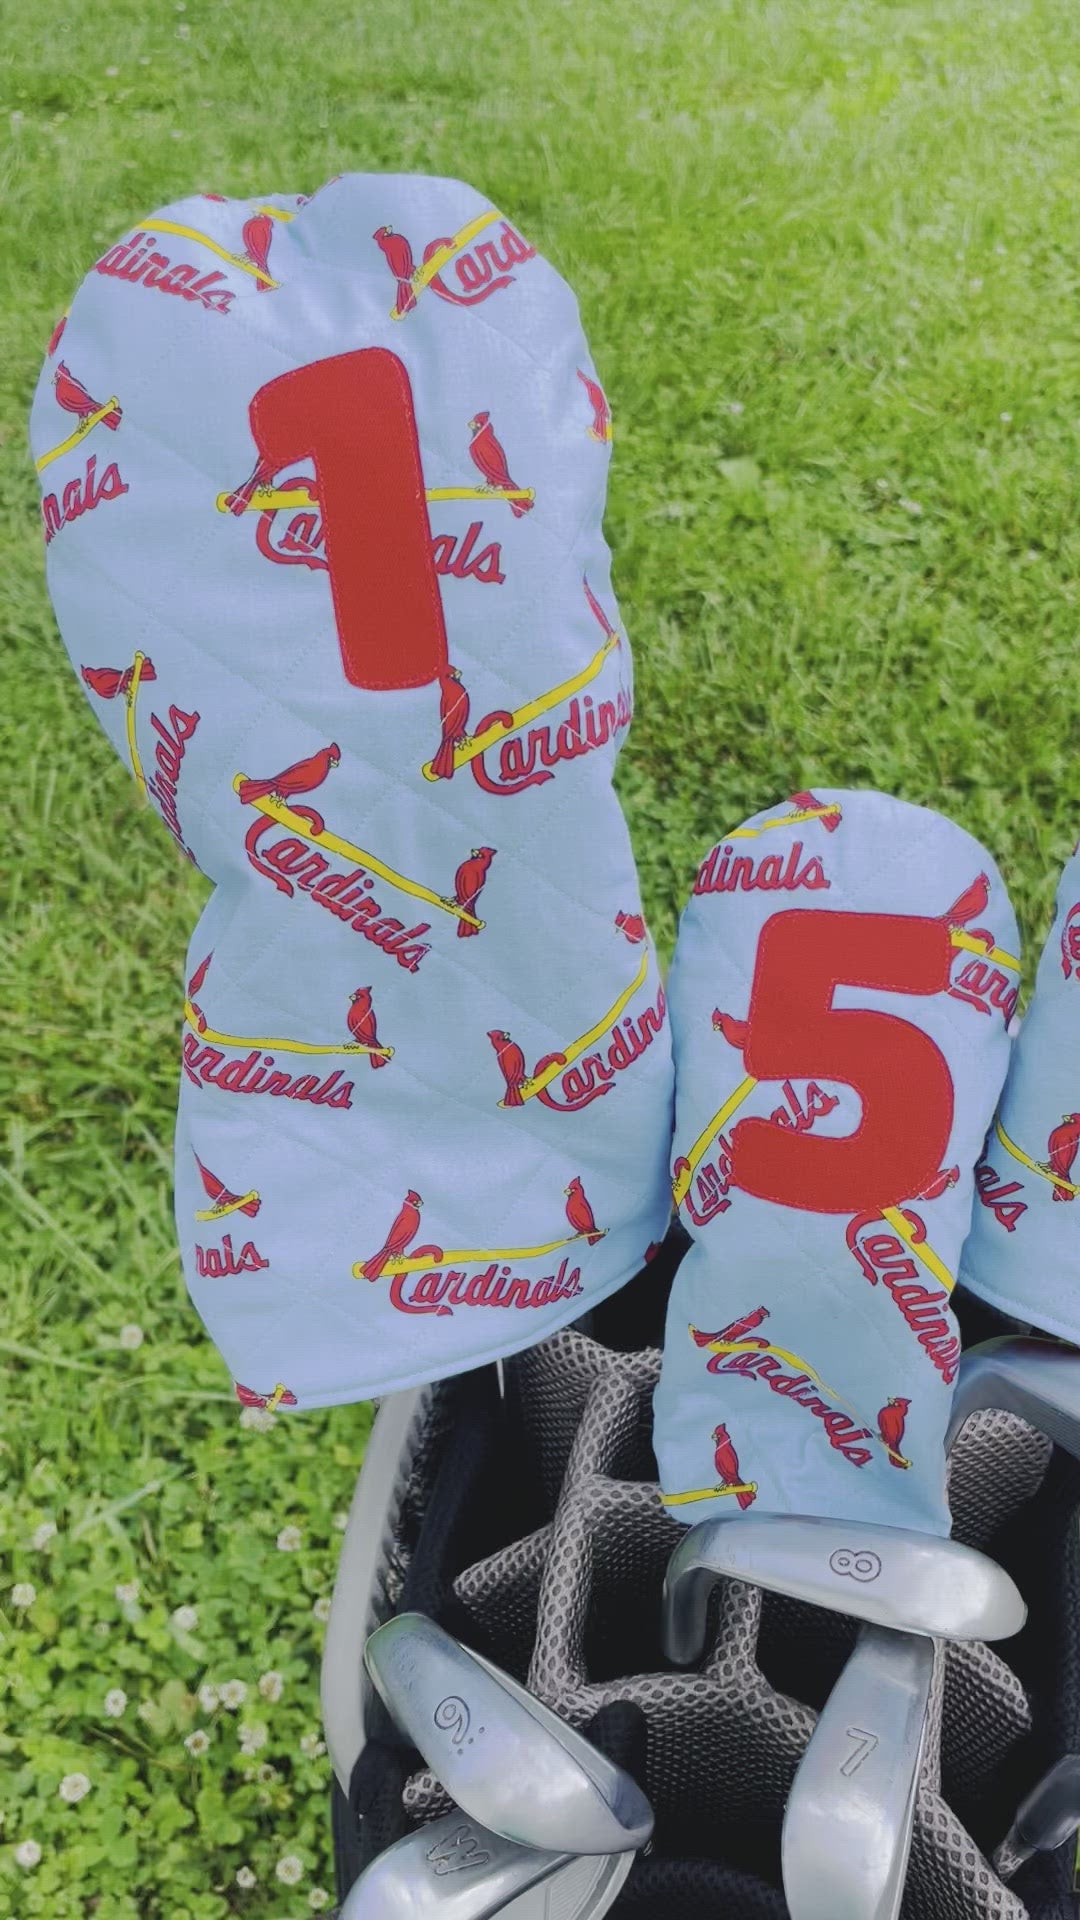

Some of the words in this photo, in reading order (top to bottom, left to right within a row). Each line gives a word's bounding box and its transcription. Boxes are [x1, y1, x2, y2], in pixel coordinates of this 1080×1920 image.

[248, 346, 449, 691] 1
[256, 477, 506, 584] Caals
[245, 804, 432, 974] Cardinals
[731, 908, 954, 1214] 5
[390, 1244, 584, 1316] Cardinals
[706, 1337, 873, 1468] Cardinals
[839, 1726, 879, 1777] 7
